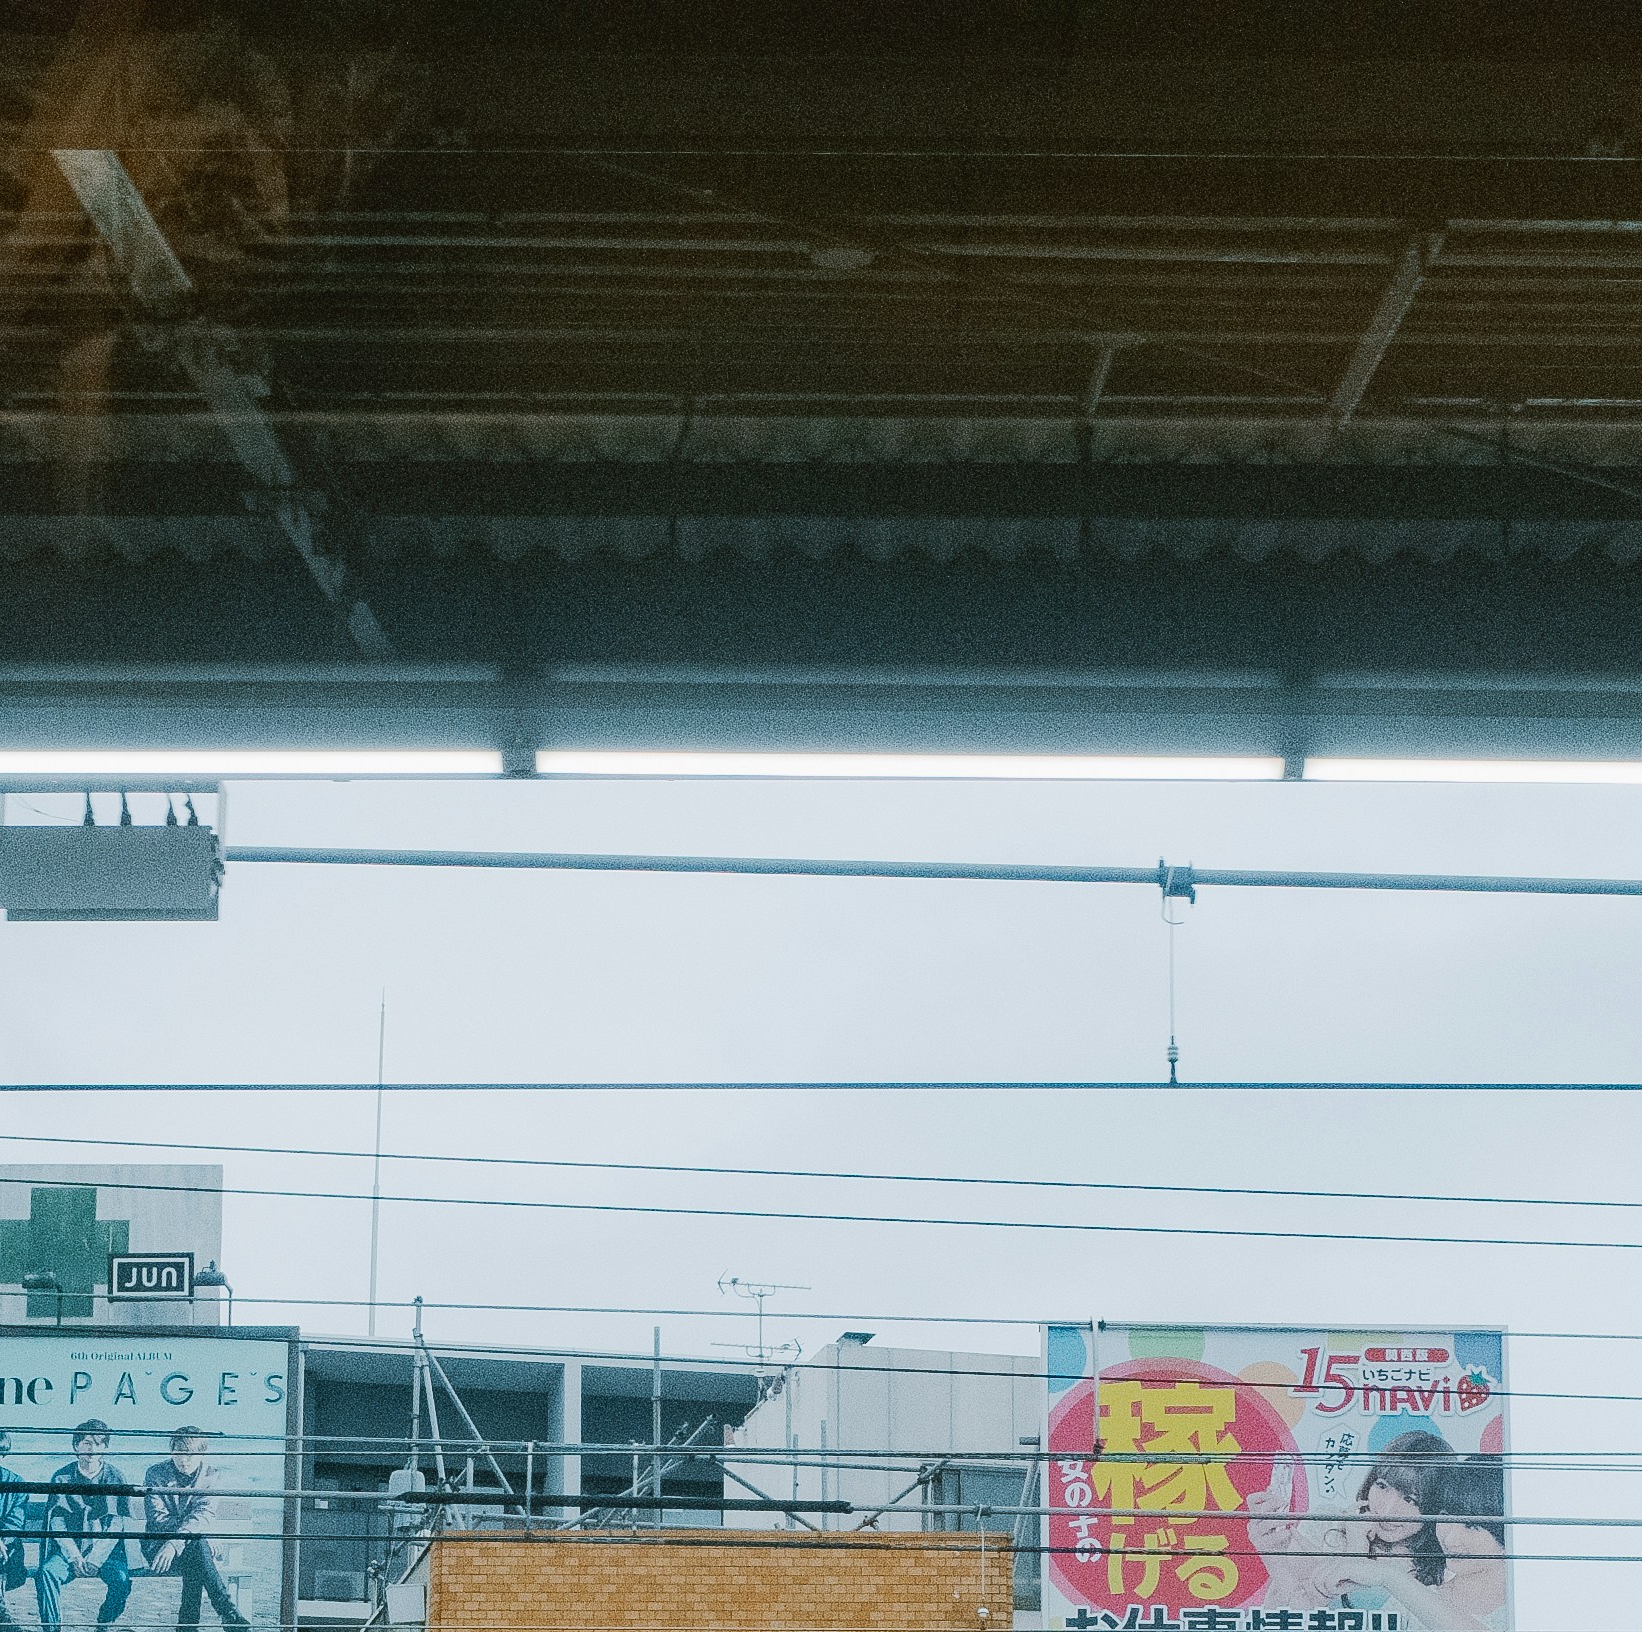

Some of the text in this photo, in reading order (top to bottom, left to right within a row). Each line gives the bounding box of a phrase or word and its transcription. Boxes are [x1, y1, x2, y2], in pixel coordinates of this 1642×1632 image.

[125, 1267, 177, 1288] JUN
[70, 1351, 172, 1362] 6th Original ALBUM
[1293, 1346, 1361, 1412] 15
[1362, 1368, 1431, 1381] いちごナビ
